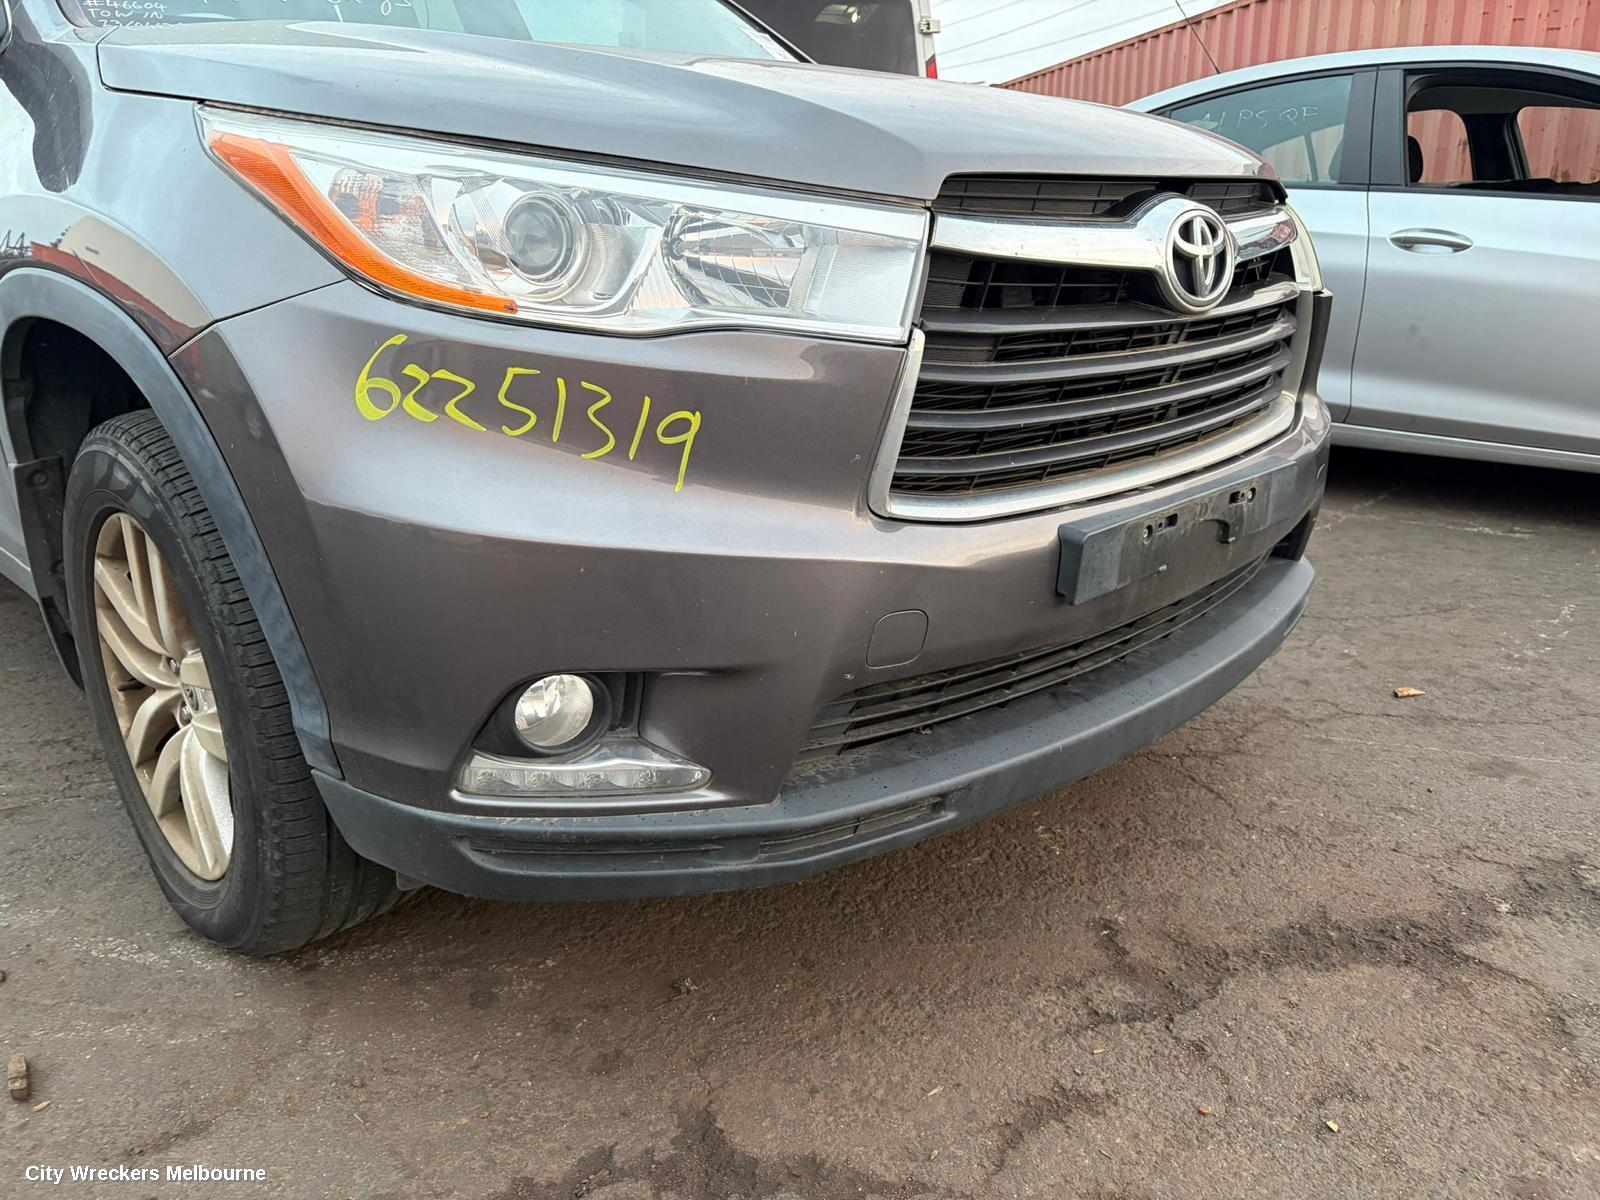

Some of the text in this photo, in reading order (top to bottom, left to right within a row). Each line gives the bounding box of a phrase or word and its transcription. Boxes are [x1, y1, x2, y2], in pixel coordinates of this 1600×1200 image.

[87, 8, 164, 19] TOW IN
[355, 333, 702, 492] 62251319
